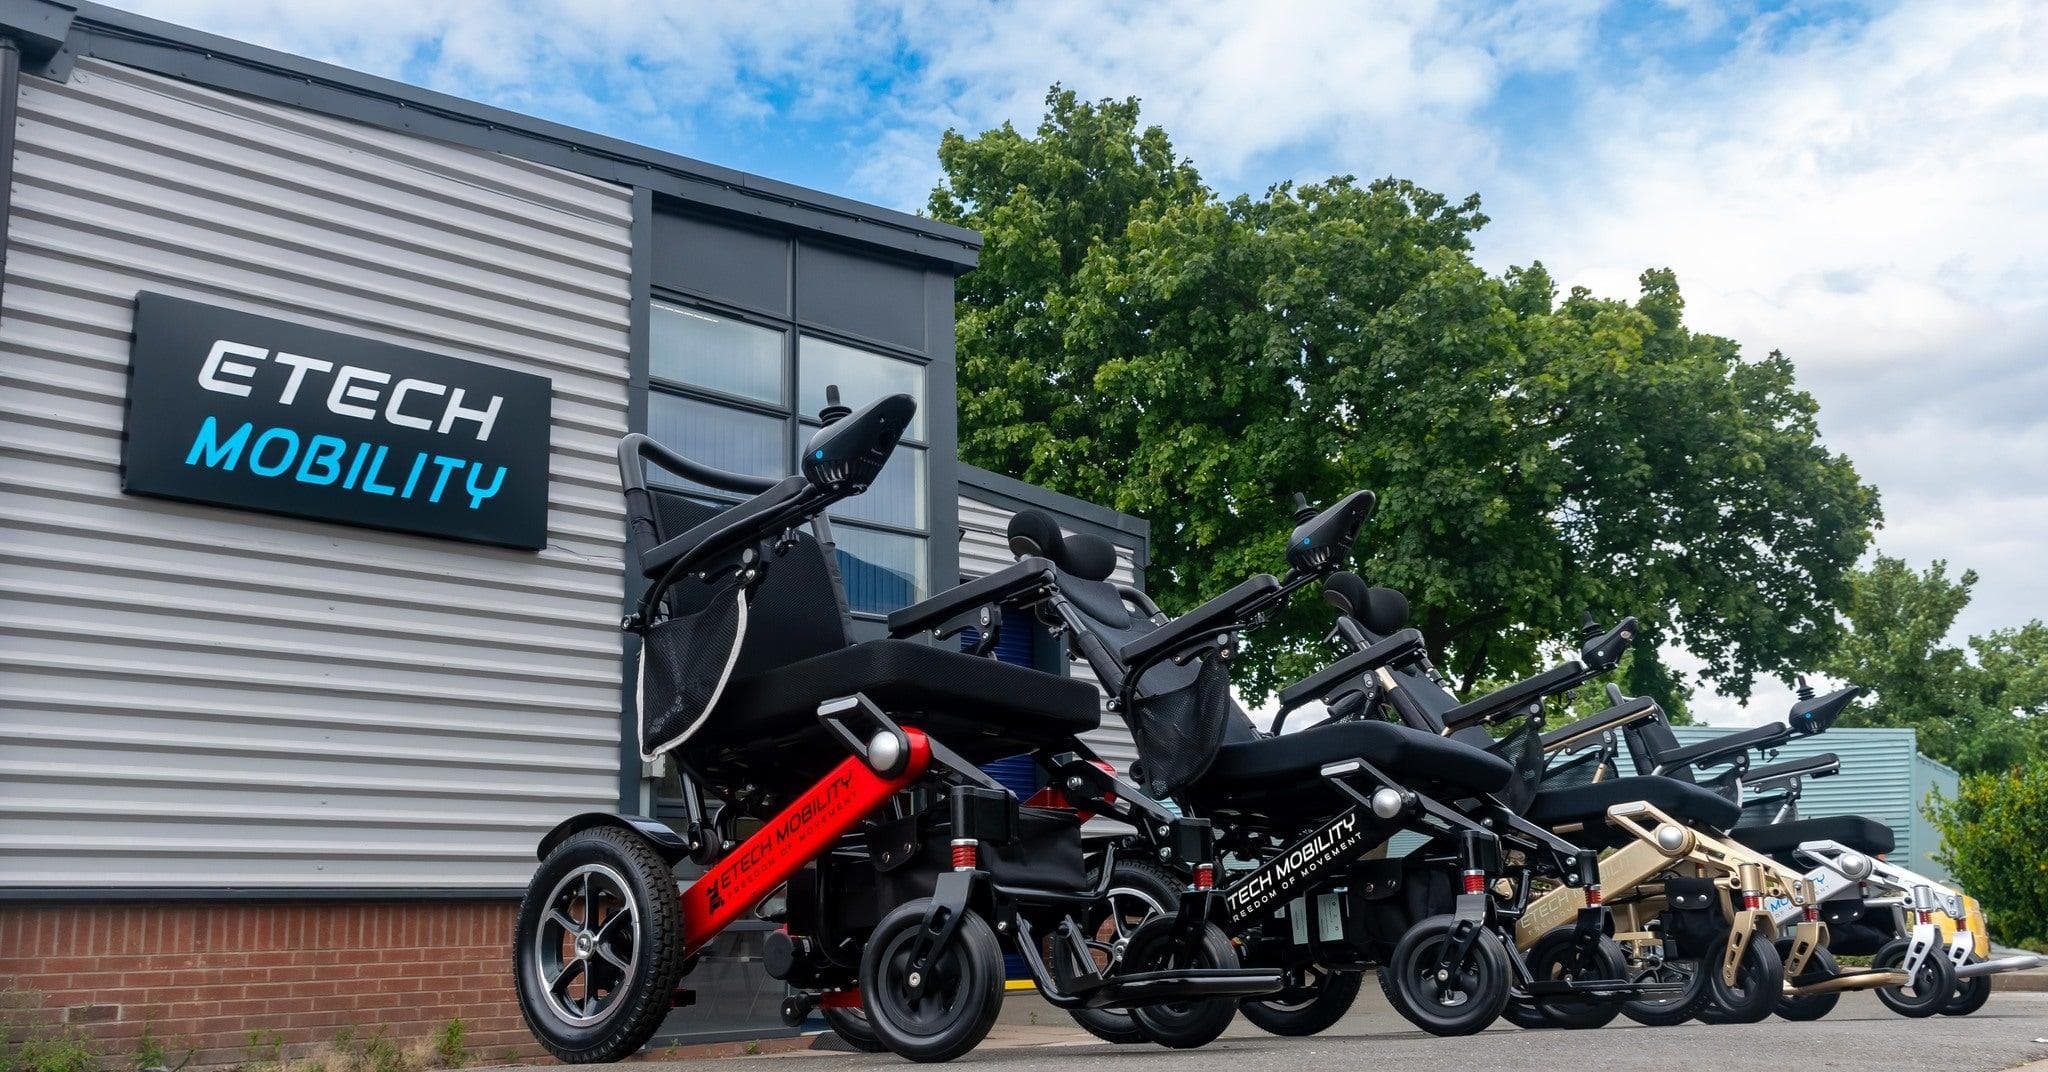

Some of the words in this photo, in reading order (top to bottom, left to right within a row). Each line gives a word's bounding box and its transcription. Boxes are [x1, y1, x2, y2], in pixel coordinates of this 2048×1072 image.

[198, 339, 503, 442] ETECH
[185, 416, 508, 509] MOBILITY
[720, 836, 772, 889] ETECH
[776, 769, 853, 845] MOBILITY
[1227, 870, 1273, 910] TECH
[1275, 813, 1356, 880] MOBILITY
[1232, 888, 1278, 922] REEDOM
[1281, 876, 1296, 890] OF
[1300, 831, 1362, 877] MOVEMENT
[1520, 890, 1570, 928] ETECH
